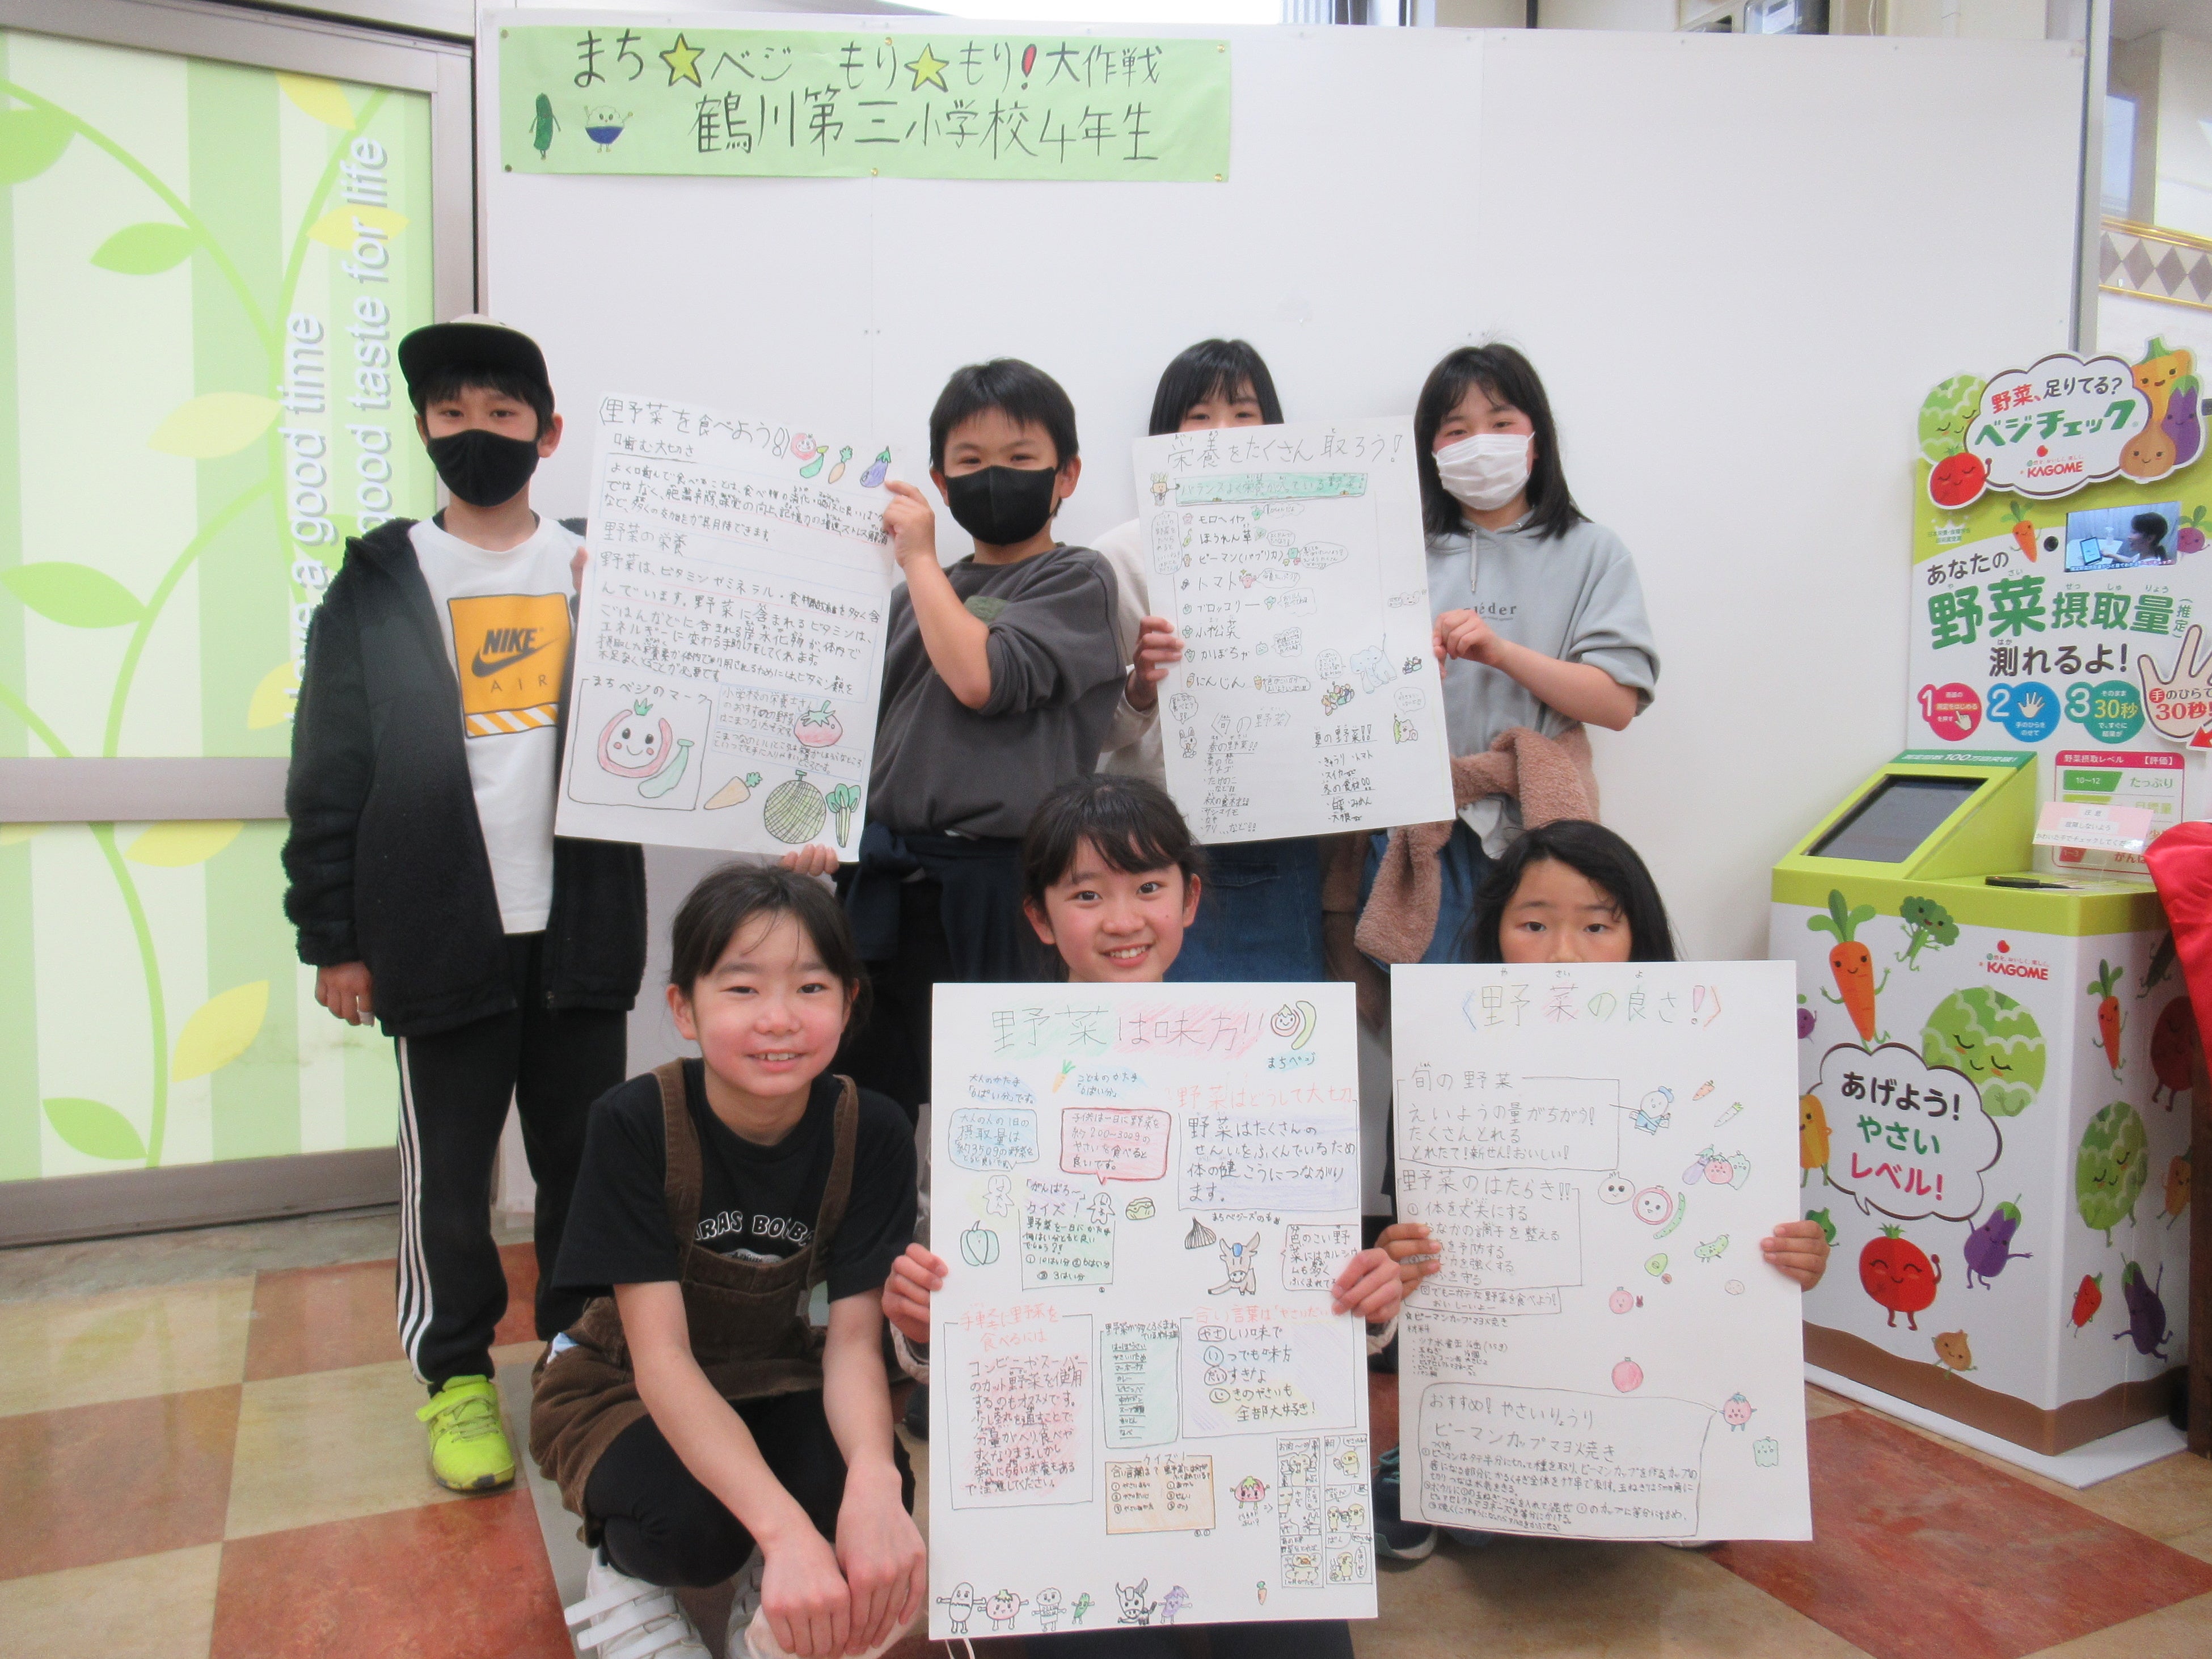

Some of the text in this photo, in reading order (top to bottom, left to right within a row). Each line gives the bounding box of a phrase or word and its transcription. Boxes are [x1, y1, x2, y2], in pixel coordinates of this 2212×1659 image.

[687, 85, 1161, 165] 鶴川第三小学校4年生
[341, 136, 389, 208] life
[341, 217, 390, 284] for
[277, 311, 326, 415] time
[344, 296, 391, 411] taste
[1991, 375, 2124, 414] 野菜、足りてる?
[1974, 398, 2137, 448] ベジチェック
[2027, 461, 2084, 478] KAGOME
[1198, 514, 1246, 525] モロヘイヤ
[1199, 530, 1252, 545] ほうれん草
[1927, 551, 2010, 585] あなたの
[1198, 570, 1237, 592] トマト
[1197, 599, 1260, 614] ブロッコリー
[483, 628, 538, 656] NIKE
[1194, 619, 1241, 640] 小松菜
[1200, 646, 1249, 662] かぼちゃ
[1989, 644, 2128, 678] 測れるよ!
[593, 674, 711, 704] まちベジのマーク
[1196, 673, 1246, 690] にんじん
[1921, 689, 1933, 717] 1
[1991, 688, 2010, 717] 2
[2070, 687, 2091, 718] 3
[2094, 700, 2138, 719] 30秒
[1355, 749, 1373, 762] トマト
[2130, 776, 2173, 789] たっぷり
[1555, 969, 1571, 978] さい
[1987, 961, 2049, 980] KAGOME
[1267, 1052, 1316, 1070] まちベジ
[1411, 1066, 1513, 1091] 旬の野菜
[1841, 1071, 1960, 1121] あげよう!
[1188, 1115, 1318, 1142] 野菜はたくさんの
[1409, 1125, 1521, 1144] たくさんとれる
[1856, 1114, 1940, 1155] やさい
[1852, 1151, 1943, 1201] レベル!
[1027, 1201, 1079, 1218] クイズ!
[980, 1329, 1048, 1352] 食べるには
[1235, 1402, 1316, 1422] 全部大好き!
